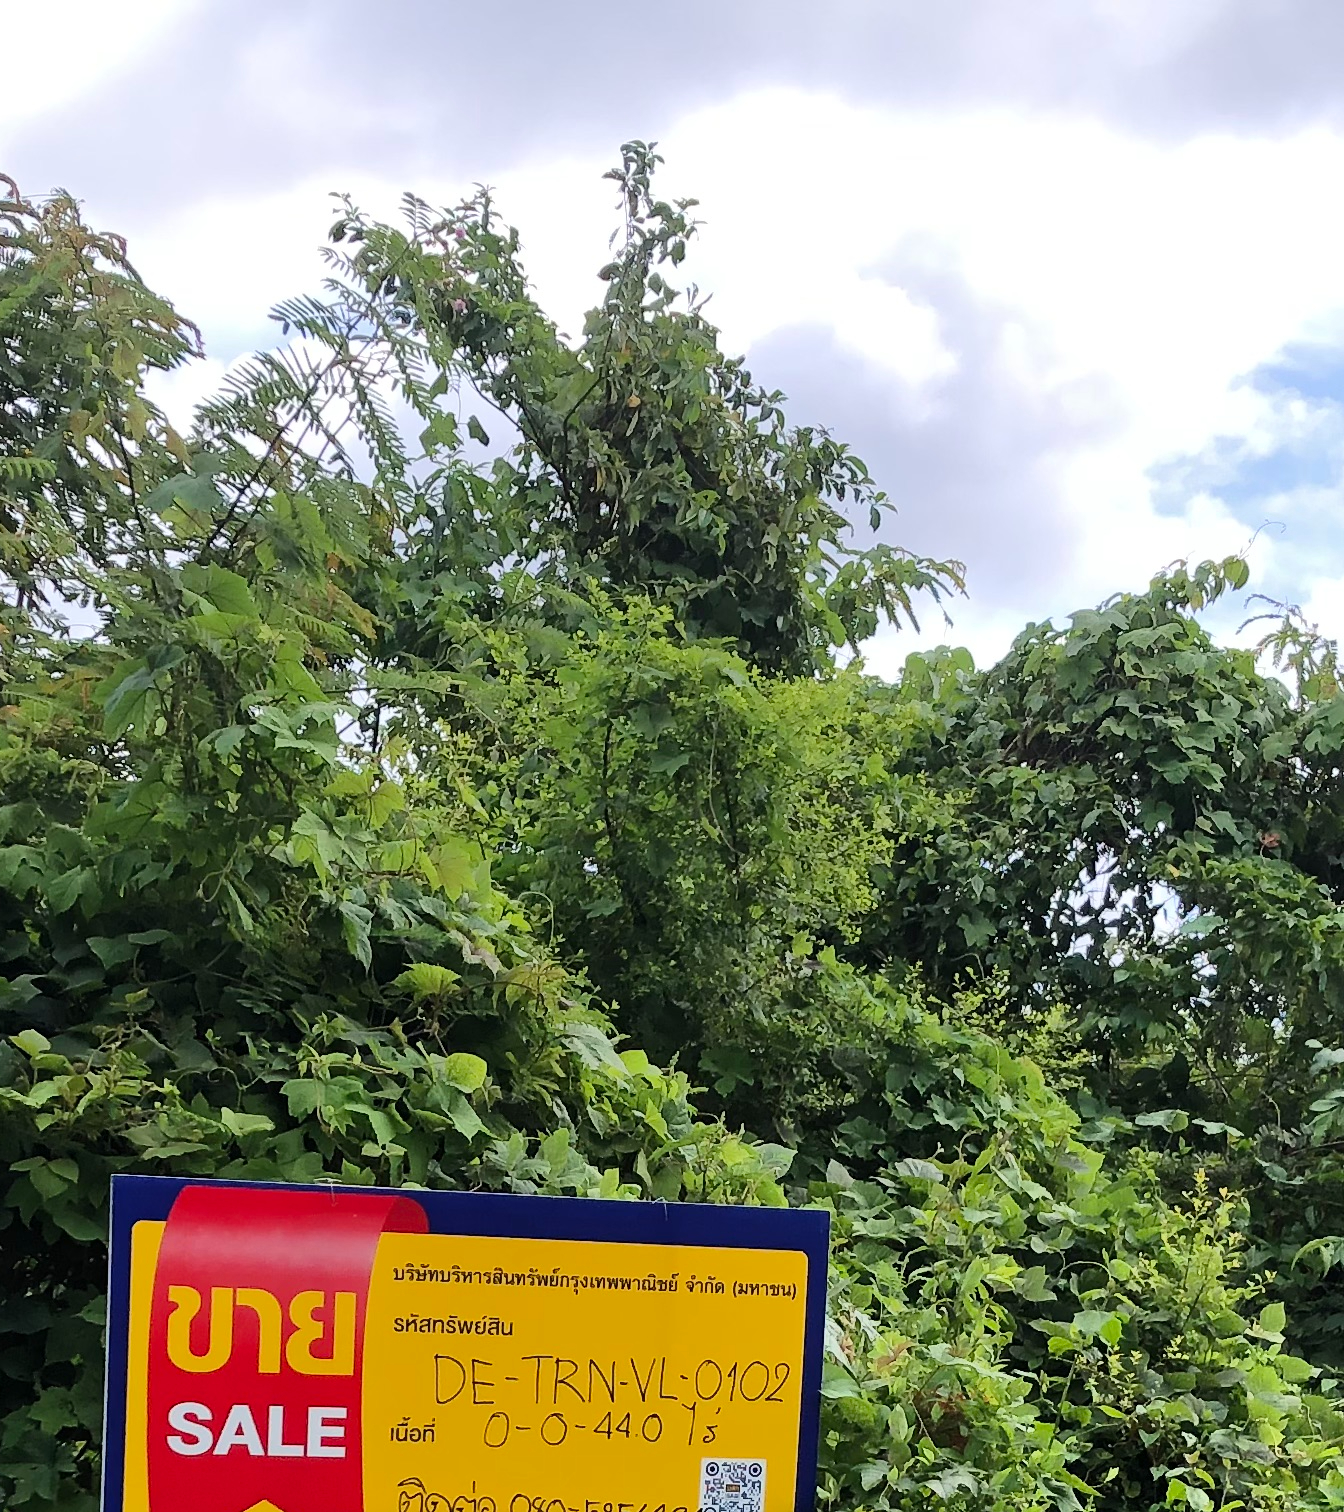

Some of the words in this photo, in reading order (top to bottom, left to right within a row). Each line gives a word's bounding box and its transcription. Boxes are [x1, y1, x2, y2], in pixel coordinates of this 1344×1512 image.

[393, 1263, 679, 1297] บริษัทบริหารสินทรัพย์กรุงเทพพาณิชย์
[686, 1277, 726, 1297] จำกัด
[731, 1280, 798, 1300] (มหาชน)
[167, 1285, 356, 1375] ขาย
[393, 1313, 514, 1337] รหัสทรัพย์สิน
[166, 1401, 348, 1458] SALE
[390, 1417, 437, 1444] เนื้อที่
